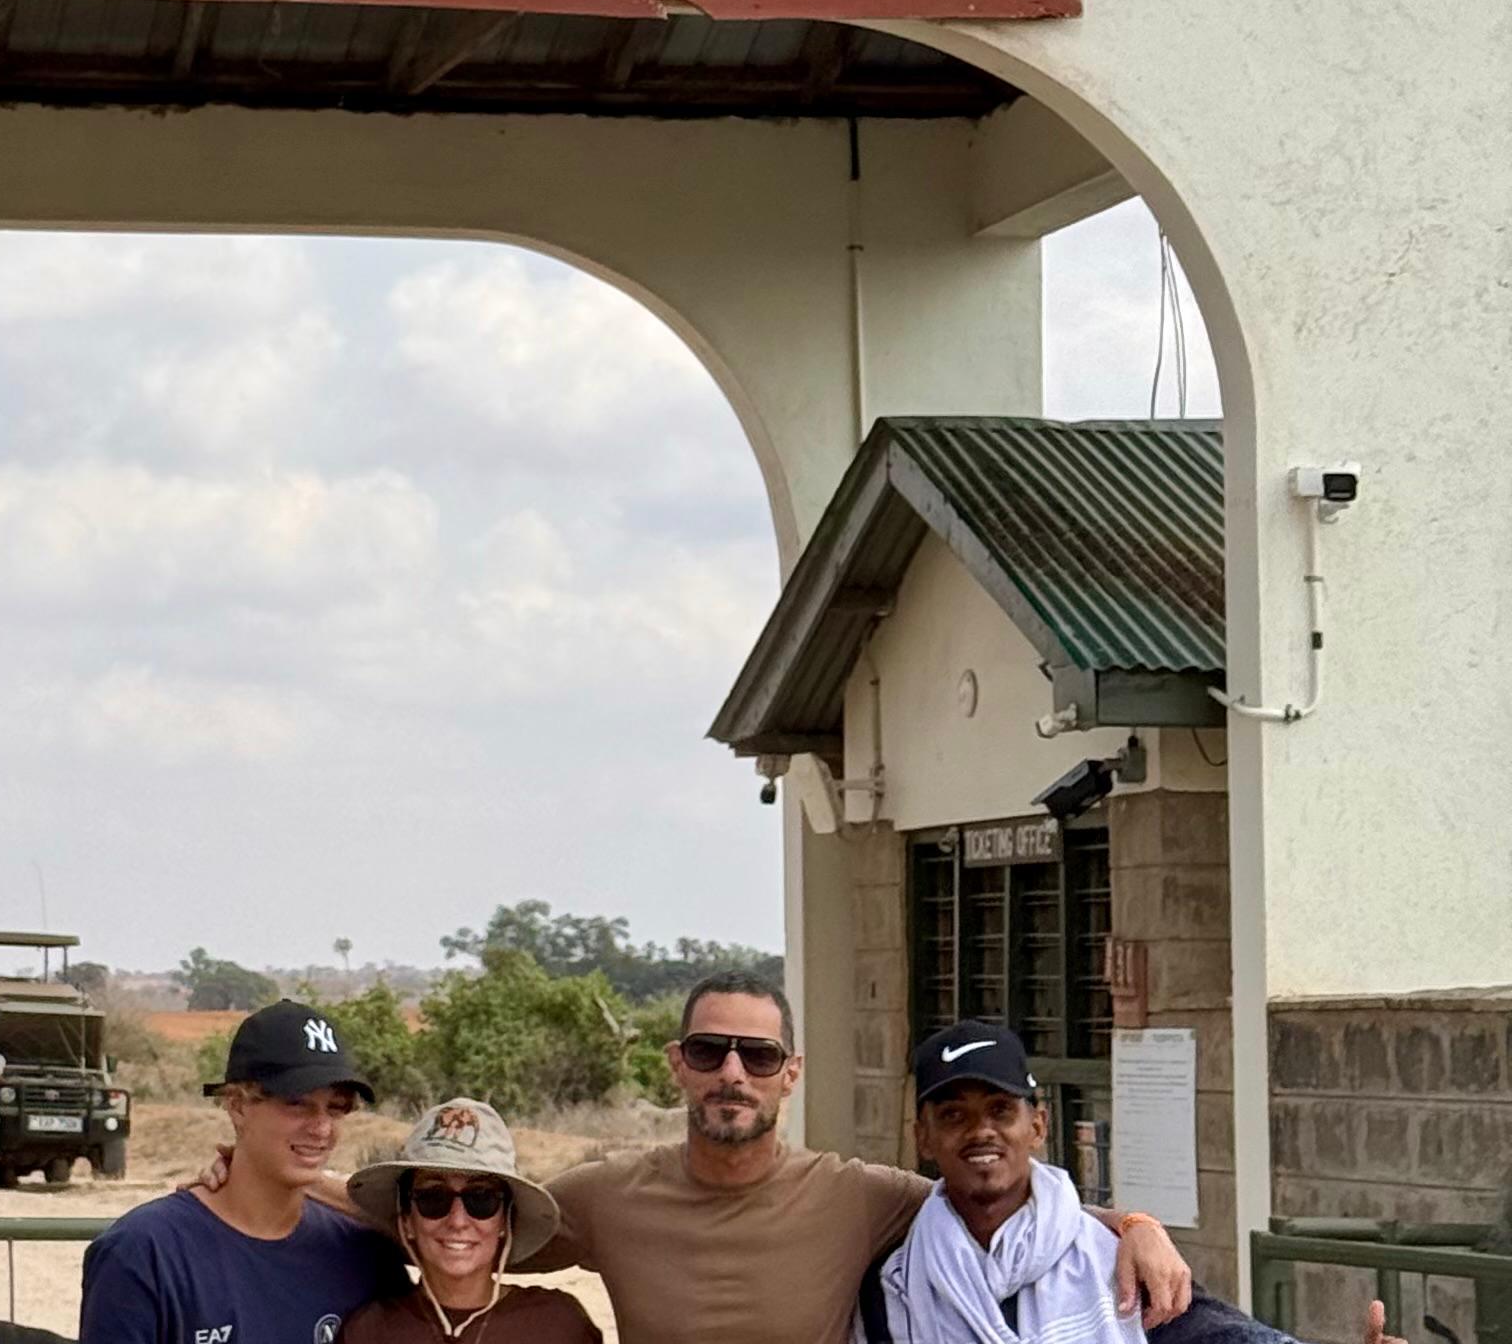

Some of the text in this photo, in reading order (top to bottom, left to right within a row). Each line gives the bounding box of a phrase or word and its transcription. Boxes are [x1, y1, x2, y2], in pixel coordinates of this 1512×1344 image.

[964, 824, 1053, 860] TICKETING OFFICE
[303, 1017, 338, 1053] NY
